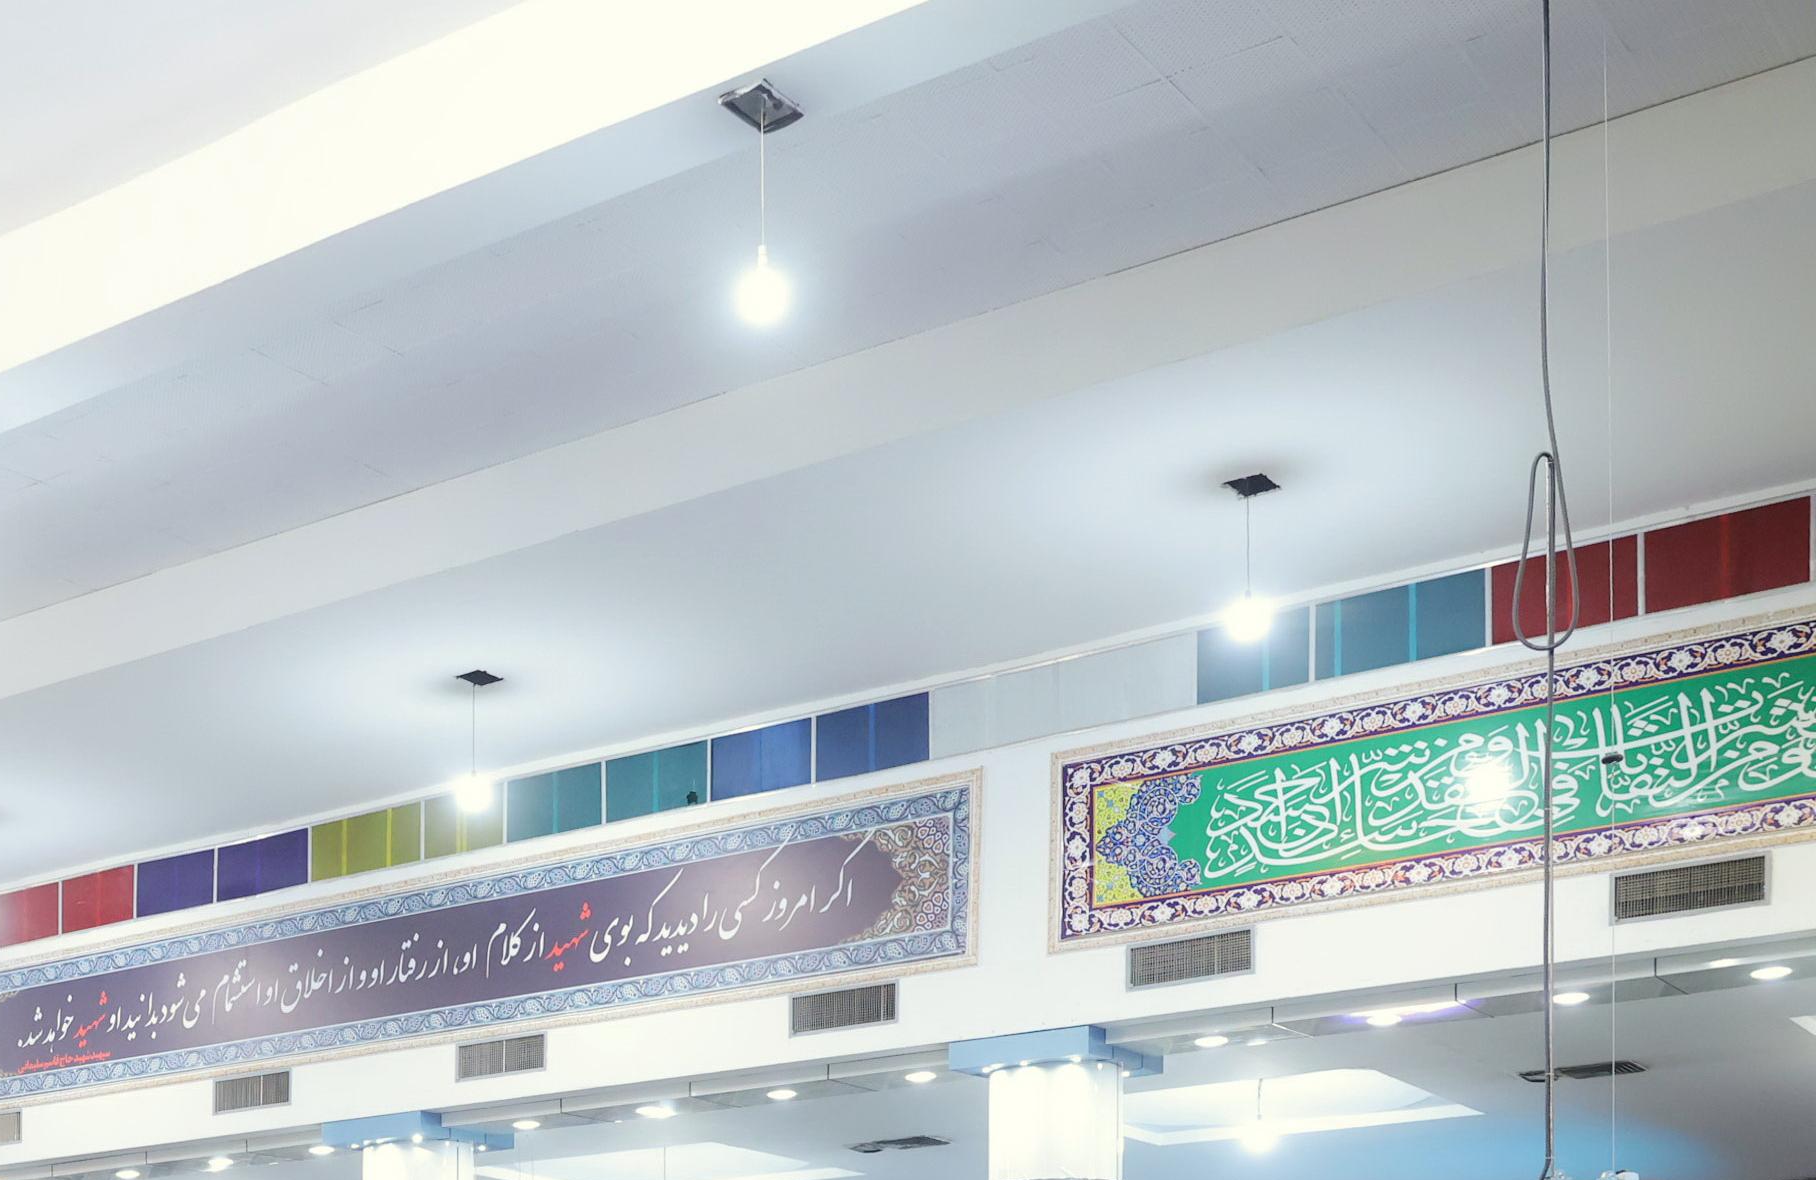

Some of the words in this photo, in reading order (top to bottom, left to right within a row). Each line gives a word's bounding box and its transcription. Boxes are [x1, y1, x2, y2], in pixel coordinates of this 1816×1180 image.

[634, 867, 684, 945] که
[718, 825, 793, 940] کسی
[762, 880, 816, 931] امروز
[545, 901, 592, 971] شهید
[652, 912, 699, 956] دیدید
[703, 892, 718, 932] را
[386, 932, 428, 986] رفتار
[428, 939, 448, 979] از
[486, 907, 536, 978] کلام
[523, 922, 545, 962] از
[589, 914, 633, 967] بوی
[211, 958, 260, 1025] استشمام
[263, 976, 279, 1006] او
[280, 948, 333, 1014] اخلاق
[334, 956, 354, 994] از
[367, 959, 384, 989] او
[41, 994, 74, 1053] خواهد
[72, 990, 109, 1048] شهید
[106, 1006, 121, 1033] او
[120, 991, 159, 1041] بدانید
